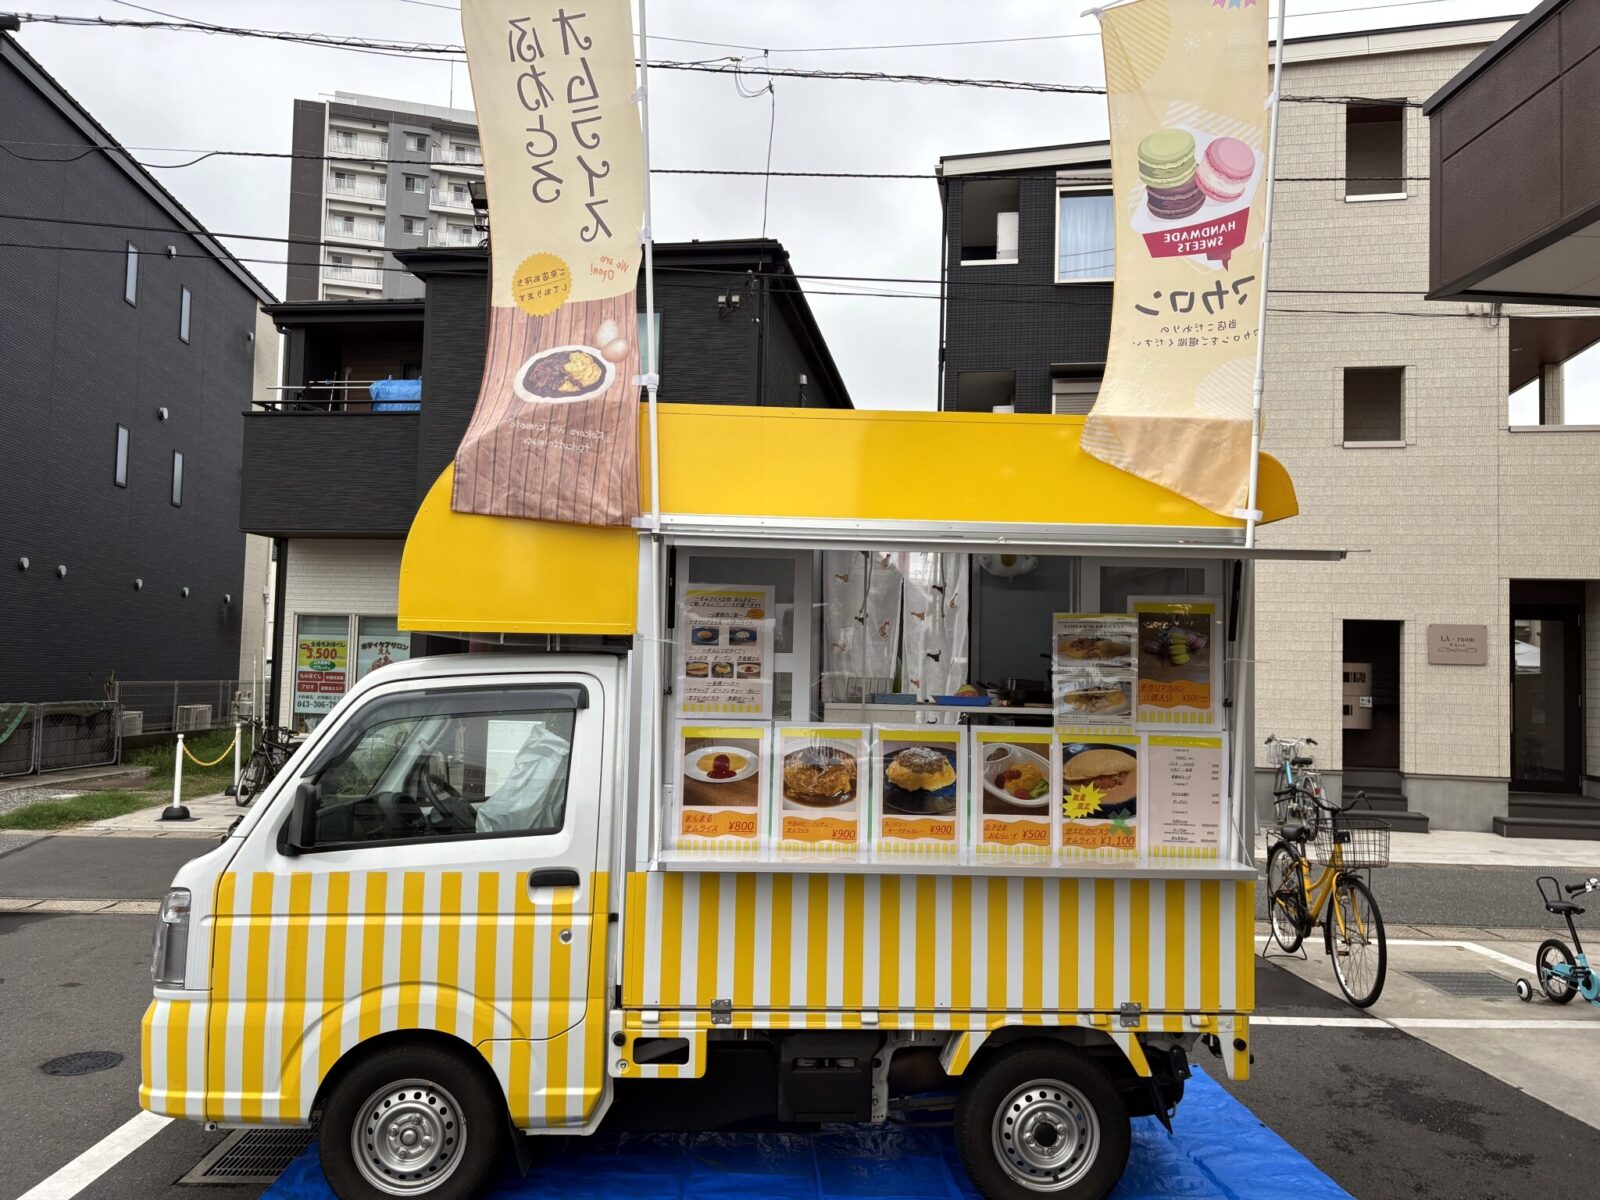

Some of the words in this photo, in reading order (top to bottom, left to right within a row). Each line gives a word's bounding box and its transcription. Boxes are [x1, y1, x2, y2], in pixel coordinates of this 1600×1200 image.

[297, 699, 338, 709] 043-306-79
[728, 820, 755, 832] ¥800
[929, 824, 953, 835] ¥900
[831, 829, 856, 839] ¥900
[1021, 829, 1047, 839] ¥500
[1100, 835, 1135, 846] ¥1,100
